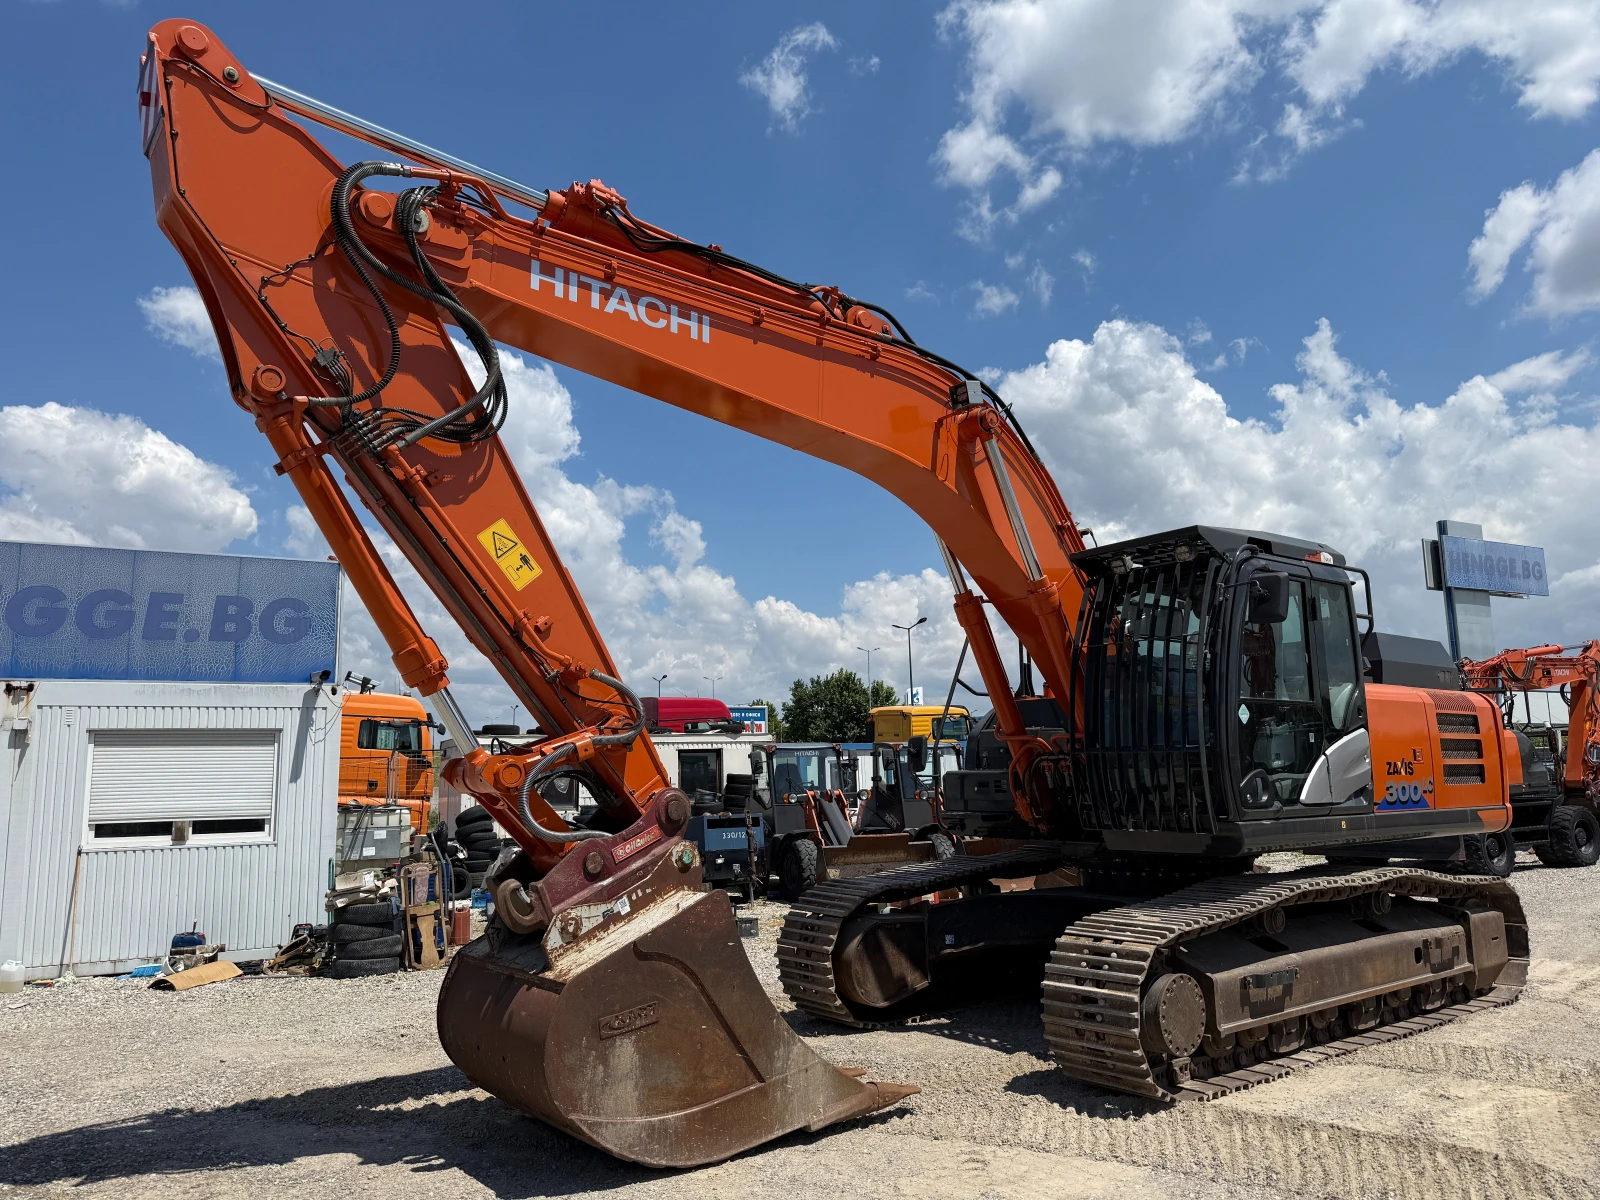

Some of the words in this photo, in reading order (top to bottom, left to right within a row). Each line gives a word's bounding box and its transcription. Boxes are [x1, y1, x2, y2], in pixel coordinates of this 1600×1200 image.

[530, 259, 710, 344] HITACHI
[0, 585, 312, 645] GGE.BG
[1386, 758, 1414, 776] ZAXIS
[1385, 780, 1422, 806] 300
